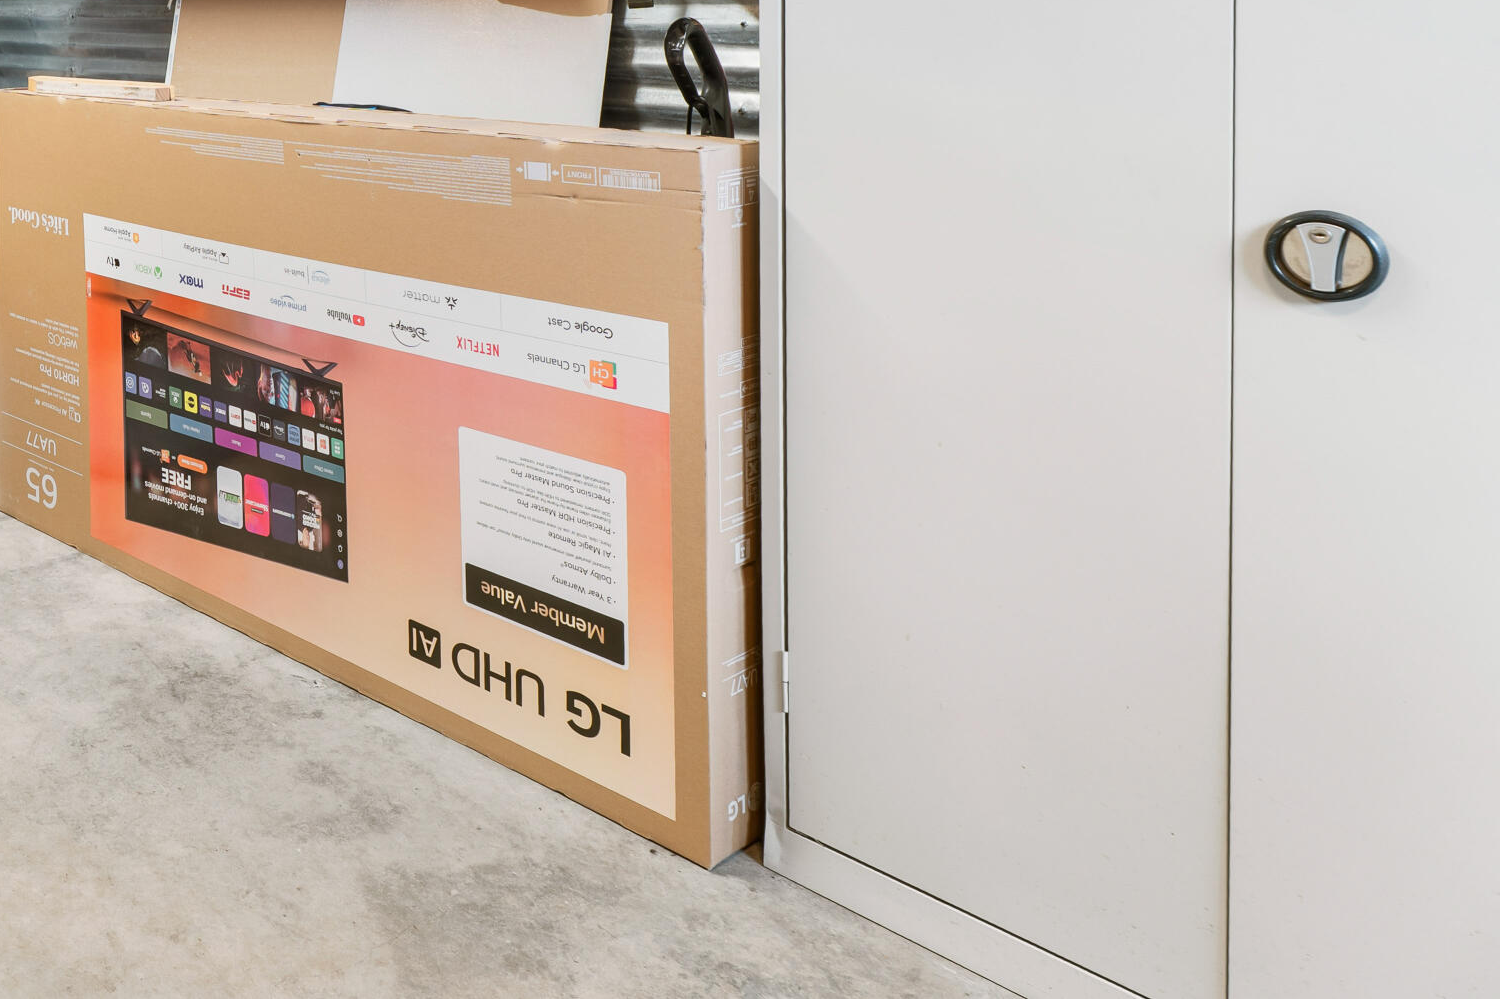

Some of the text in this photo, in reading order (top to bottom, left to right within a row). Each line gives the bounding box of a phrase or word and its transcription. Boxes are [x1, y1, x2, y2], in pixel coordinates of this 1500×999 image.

[566, 170, 592, 179] FRONT
[8, 206, 69, 236] Life's Good.
[179, 274, 204, 289] max
[222, 284, 250, 300] ESPN
[402, 290, 441, 305] matter
[326, 308, 352, 323] YouTube
[547, 317, 614, 339] Google Cast
[47, 331, 78, 350] webOS
[455, 335, 500, 357] NETFLIX
[39, 363, 80, 387] HDR10 Pro
[526, 352, 586, 375] LG Channels
[593, 366, 609, 380] CH
[26, 429, 57, 457] UA77
[25, 466, 58, 510] 65
[161, 467, 192, 490] FREE
[510, 468, 611, 504] Precision Sound Master Pro
[144, 480, 207, 505] and on-demand movies
[148, 492, 205, 516] Enjoy 300+ channels
[516, 498, 611, 535] Precision HDR Master Pro
[548, 531, 612, 559] AI Magic Remote
[551, 575, 585, 595] Warranty
[590, 569, 612, 584] Dolby
[588, 589, 604, 601] Year
[480, 580, 605, 644] Member Value
[411, 627, 438, 658] AI
[451, 642, 630, 758] LG UHD
[727, 794, 746, 822] LG
